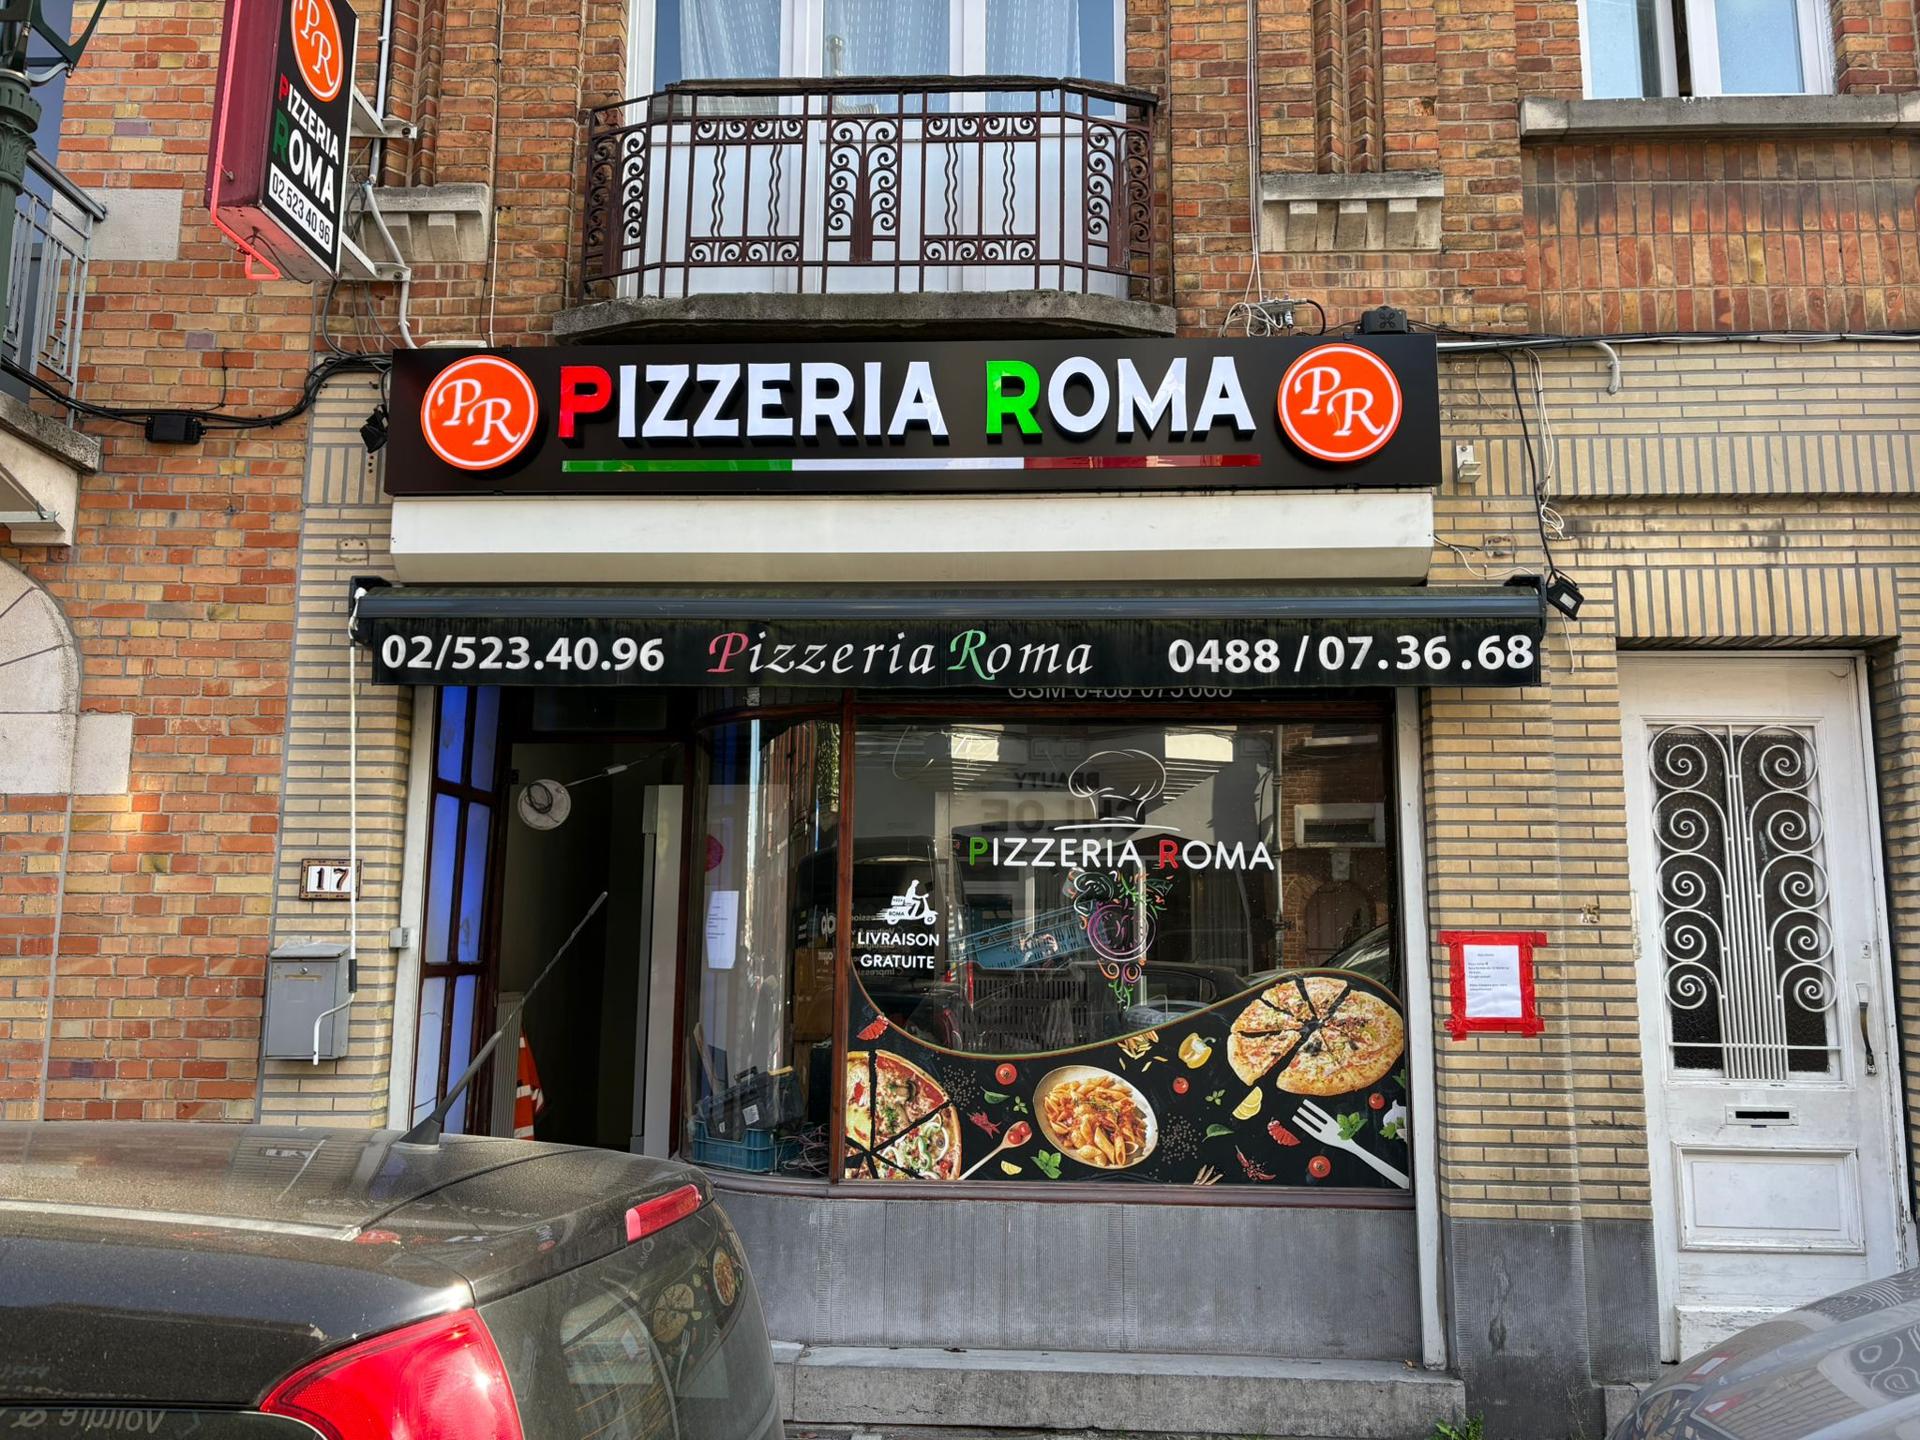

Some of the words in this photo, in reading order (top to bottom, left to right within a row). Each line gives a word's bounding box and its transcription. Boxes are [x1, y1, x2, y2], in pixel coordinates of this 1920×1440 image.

[279, 73, 339, 165] PIZZERIA
[273, 108, 335, 214] ROMA
[272, 173, 284, 200] 02
[285, 185, 304, 220] 523
[305, 204, 318, 232] 40
[318, 218, 331, 244] 96
[437, 376, 521, 445] PR
[558, 361, 948, 438] PIZZERIA
[986, 356, 1256, 434] ROMA
[1294, 366, 1384, 437] PR
[381, 634, 665, 672] 02/523.40.96
[706, 631, 936, 674] Pizzeria
[947, 628, 1093, 681] Roma
[316, 867, 349, 890] 17
[969, 836, 1143, 868] PIZZERIA
[1158, 839, 1275, 870] ROMA
[857, 932, 940, 946] LIVRAISON
[860, 954, 935, 969] GRATUITE
